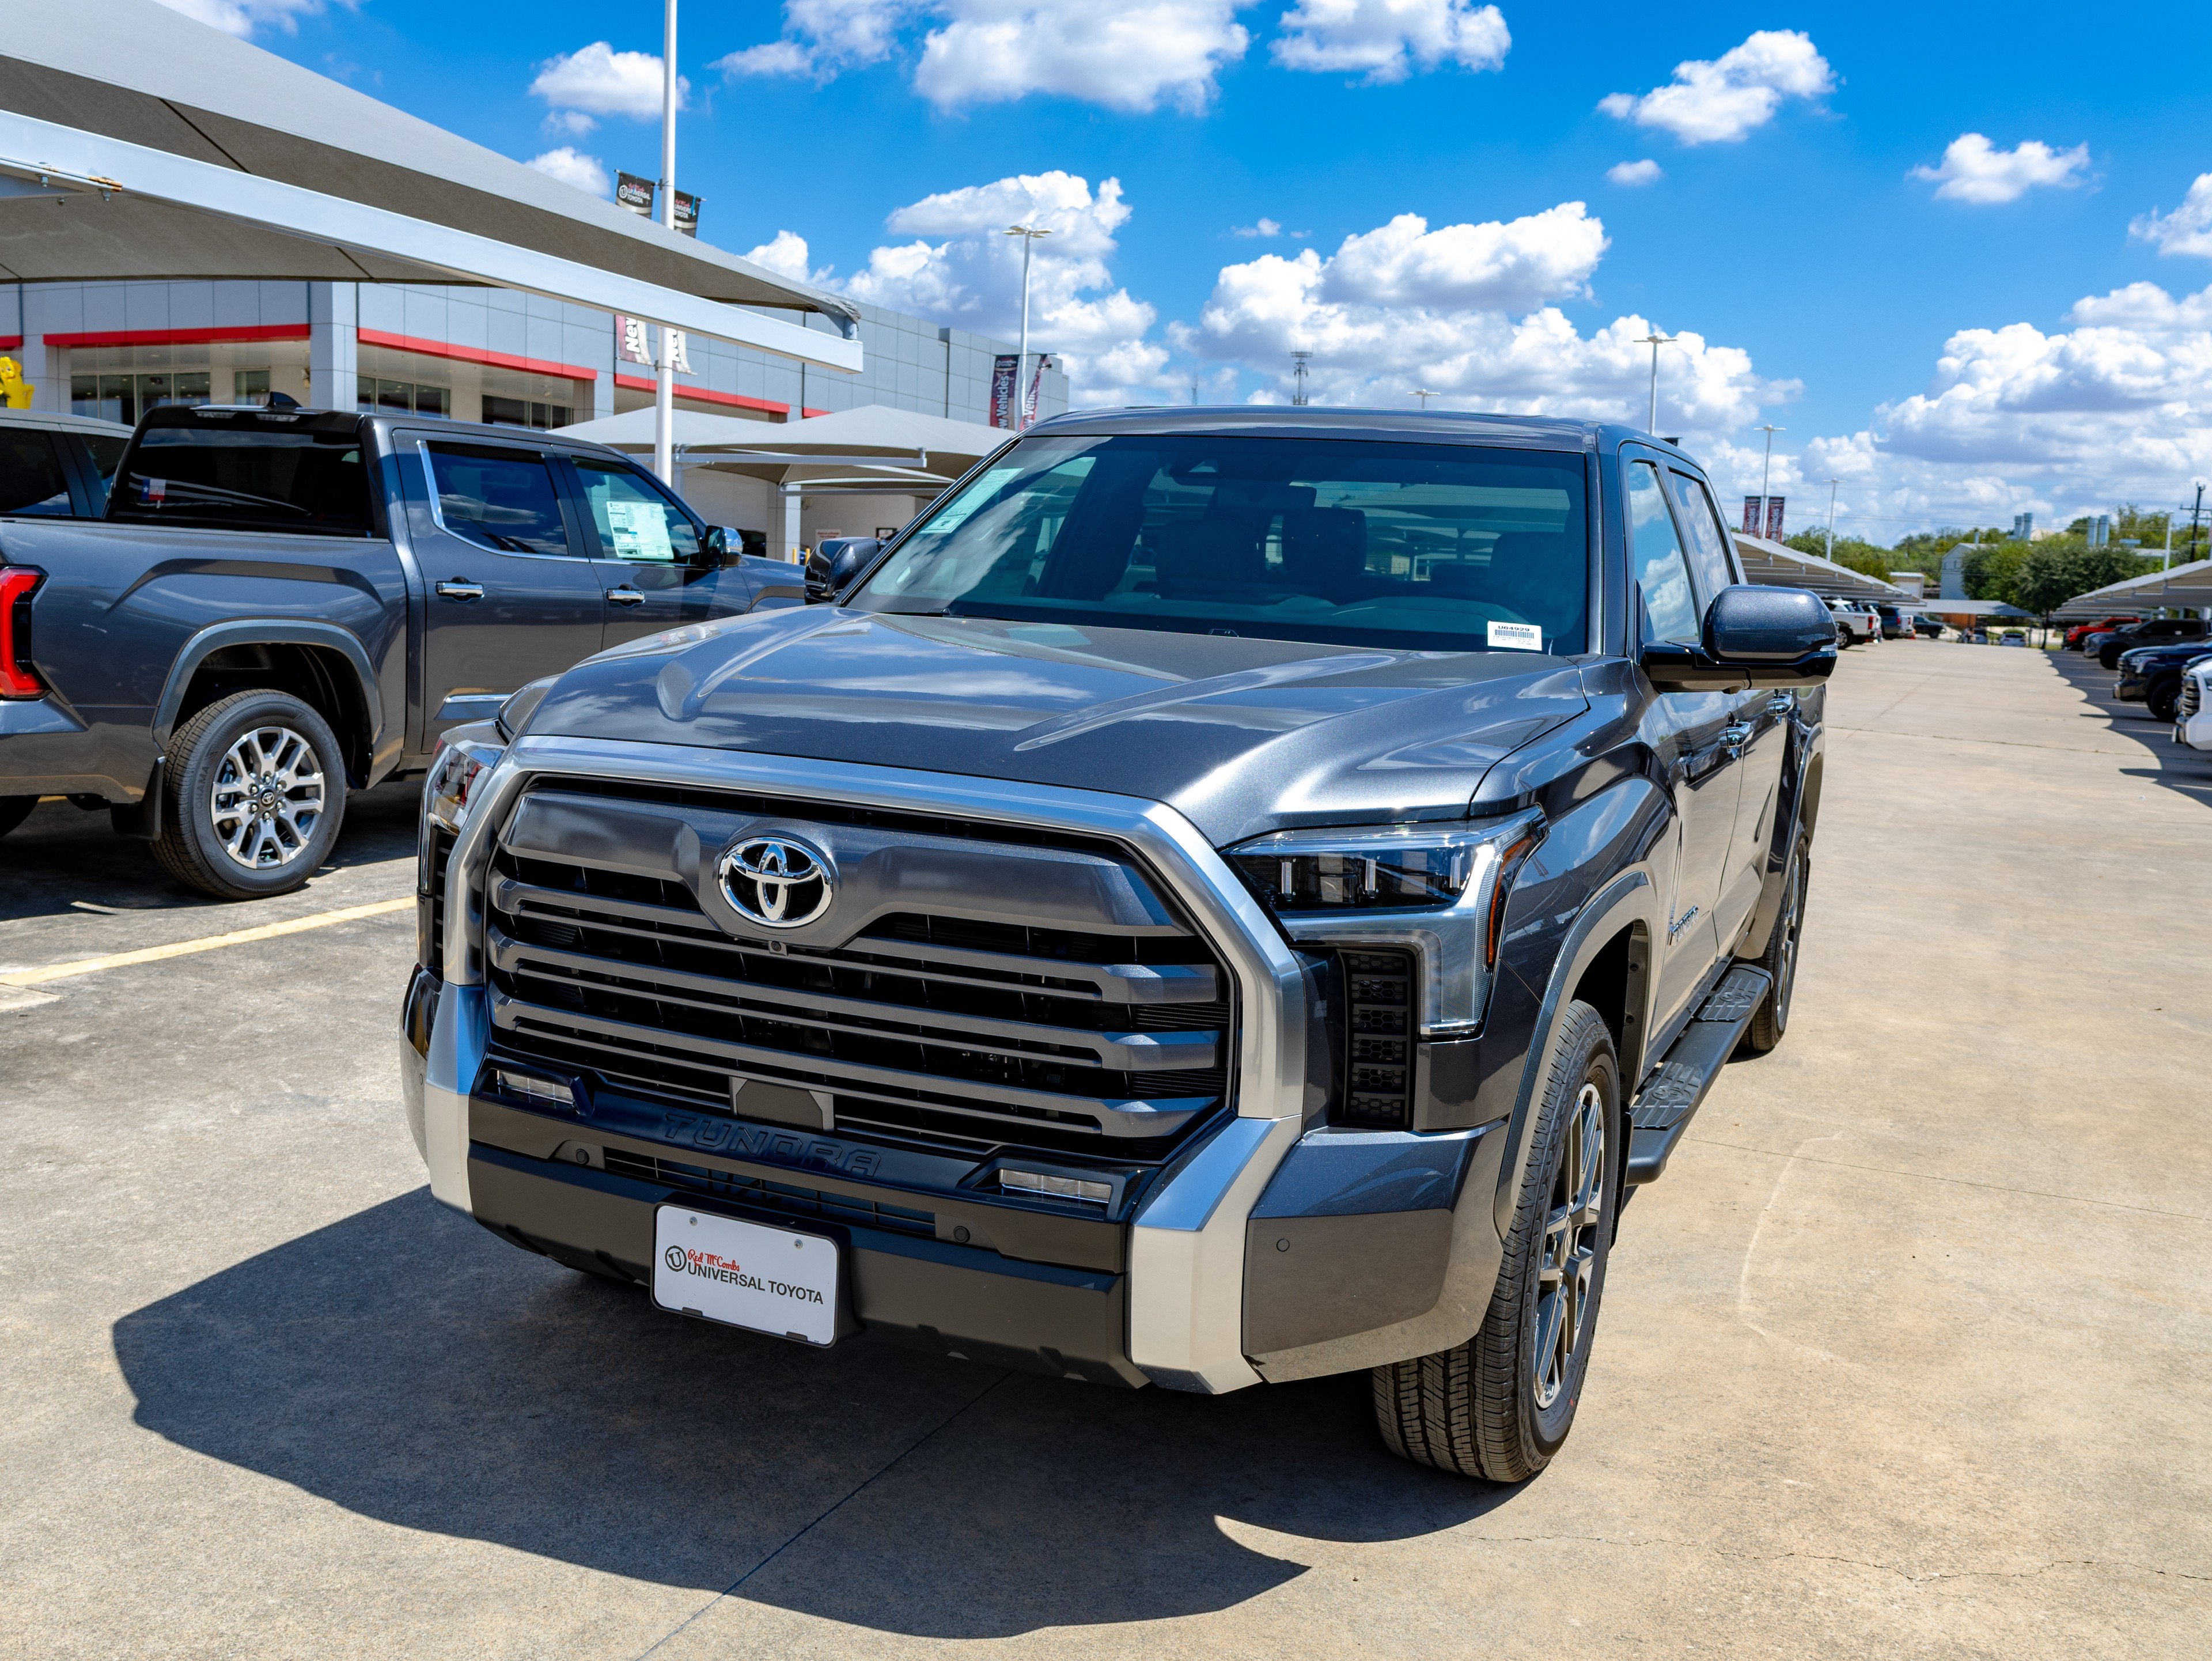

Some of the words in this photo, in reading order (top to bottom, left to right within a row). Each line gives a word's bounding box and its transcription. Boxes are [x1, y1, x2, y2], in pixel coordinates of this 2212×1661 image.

[627, 195, 643, 204] TOYOTA
[628, 188, 651, 200] UVERSAL
[674, 203, 696, 217] UNIVERSL
[996, 375, 1010, 417] Vehicles
[665, 1113, 882, 1178] TUNDRA
[688, 1249, 703, 1266] Red
[704, 1253, 740, 1272] McCombs
[688, 1262, 765, 1292] UNIVERSAL
[768, 1280, 824, 1304] TOYOTA
